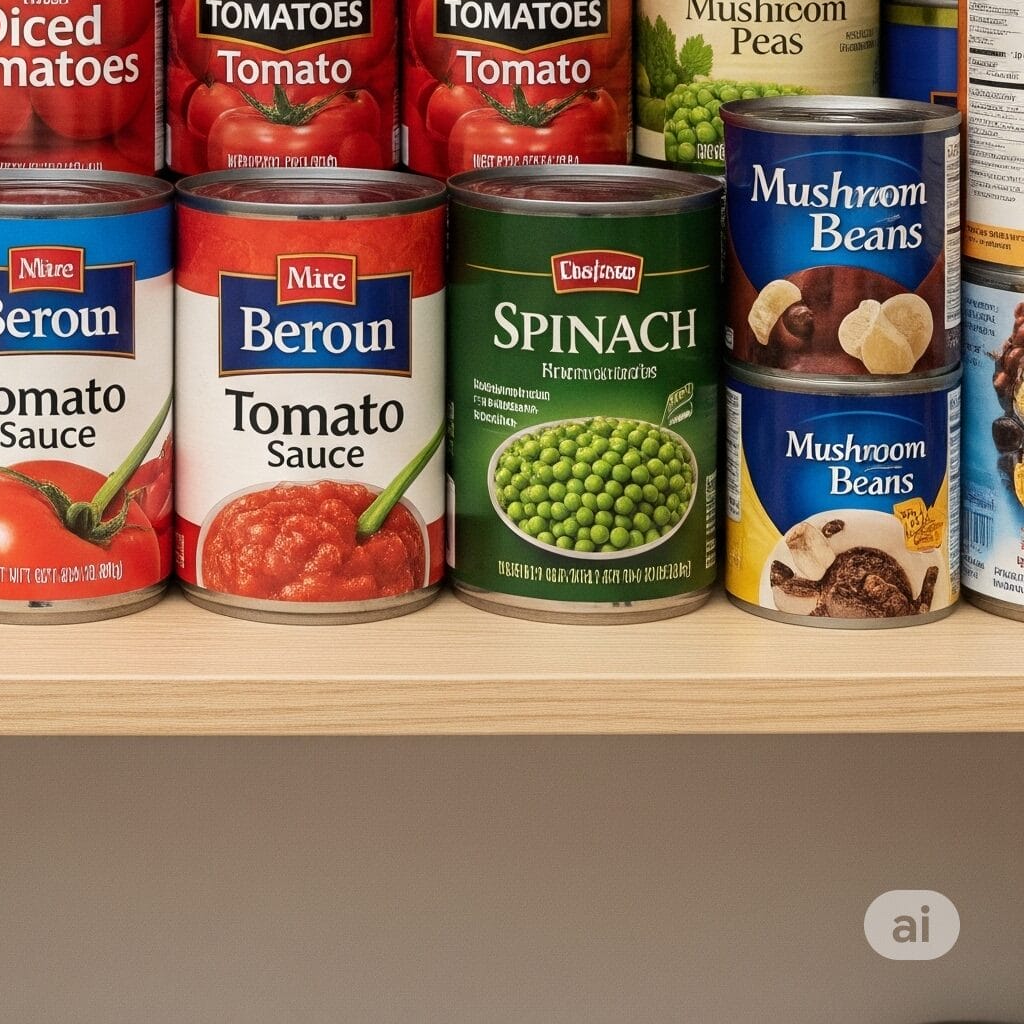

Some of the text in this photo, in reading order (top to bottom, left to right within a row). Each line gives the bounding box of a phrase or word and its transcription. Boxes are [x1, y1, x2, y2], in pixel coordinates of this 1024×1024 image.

[206, 0, 363, 31] TOMATOES
[444, 0, 602, 30] TOMATOES
[731, 27, 804, 55] Peas
[217, 50, 352, 85] Tomato
[456, 50, 591, 85] Tomato
[809, 212, 923, 252] Beans
[493, 301, 697, 354] SPINACH
[225, 388, 404, 437] Tomato
[0, 420, 96, 450] Sauce
[785, 430, 926, 463] Mushroom
[267, 439, 365, 469] Sauce
[828, 466, 914, 495] Beans
